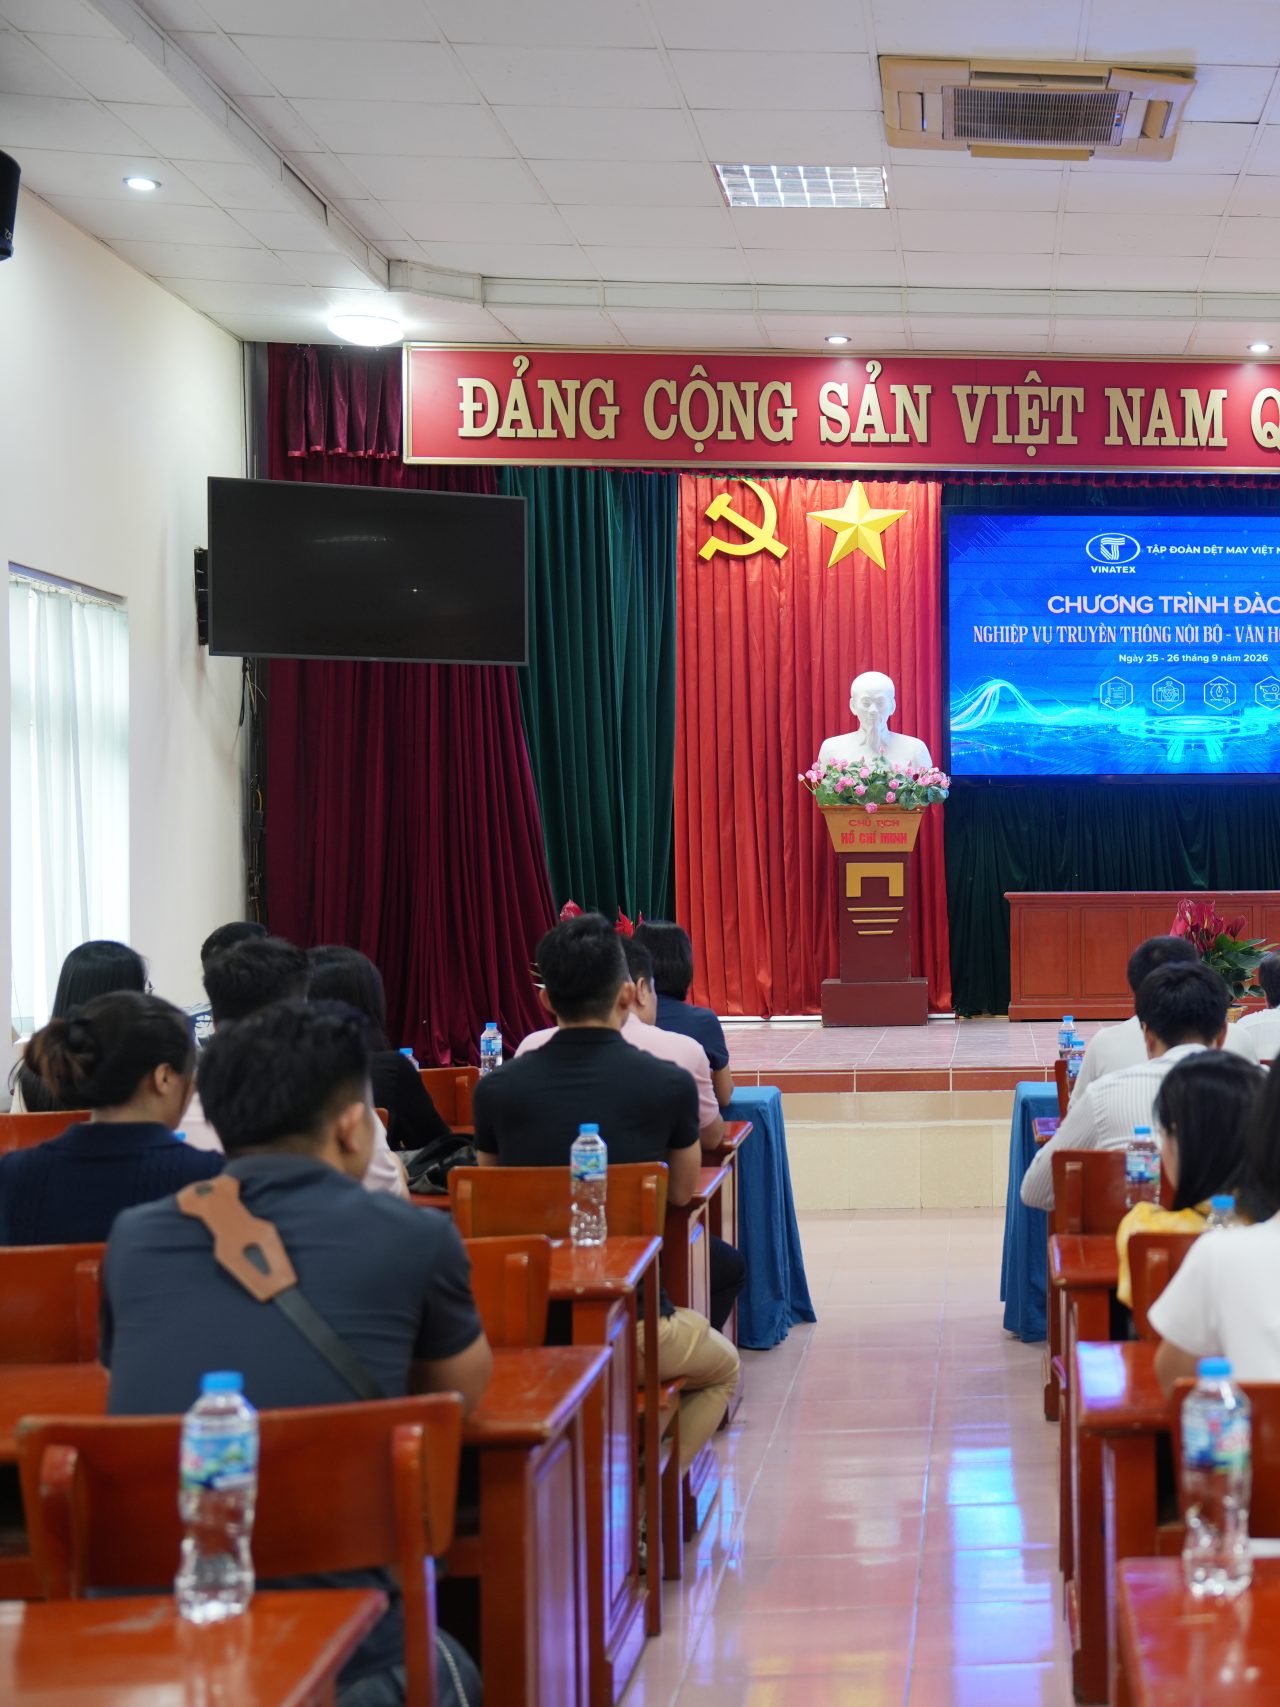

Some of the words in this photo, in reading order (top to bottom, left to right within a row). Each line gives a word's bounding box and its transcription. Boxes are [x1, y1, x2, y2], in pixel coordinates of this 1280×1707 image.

[457, 355, 620, 440] ĐẢNG
[643, 365, 797, 453] CỘNG
[819, 360, 932, 444] SẢN
[951, 370, 1085, 457] VIỆT
[1104, 387, 1229, 447] NAM
[1146, 543, 1167, 556] TẬP
[1169, 543, 1200, 554] ĐOÀN
[1204, 544, 1223, 556] DỆT
[1226, 546, 1249, 555] MAY
[1251, 544, 1274, 556] VIỆT
[1090, 565, 1136, 574] VINATEX
[1047, 594, 1154, 614] CHƯƠNG
[1159, 591, 1229, 614] TRÌNH
[973, 623, 1029, 645] NGHIỆP
[1032, 625, 1053, 645] VỤ
[1056, 622, 1117, 644] TRUYỀN
[1119, 623, 1172, 643] THÔNG
[1176, 623, 1200, 645] NỘI
[1203, 623, 1223, 645] BỘ
[1235, 624, 1264, 643] VĂN
[1119, 653, 1144, 664] Ngày
[1146, 653, 1159, 662] 25
[1167, 653, 1180, 662] 26
[1182, 653, 1210, 664] tháng
[1211, 653, 1218, 662] 9
[1220, 653, 1241, 662] năm
[1243, 653, 1269, 662] 2026
[848, 816, 872, 827] CHỦ
[876, 819, 900, 828] TỊCH
[859, 830, 877, 844] CHÍ
[880, 832, 908, 844] MINH
